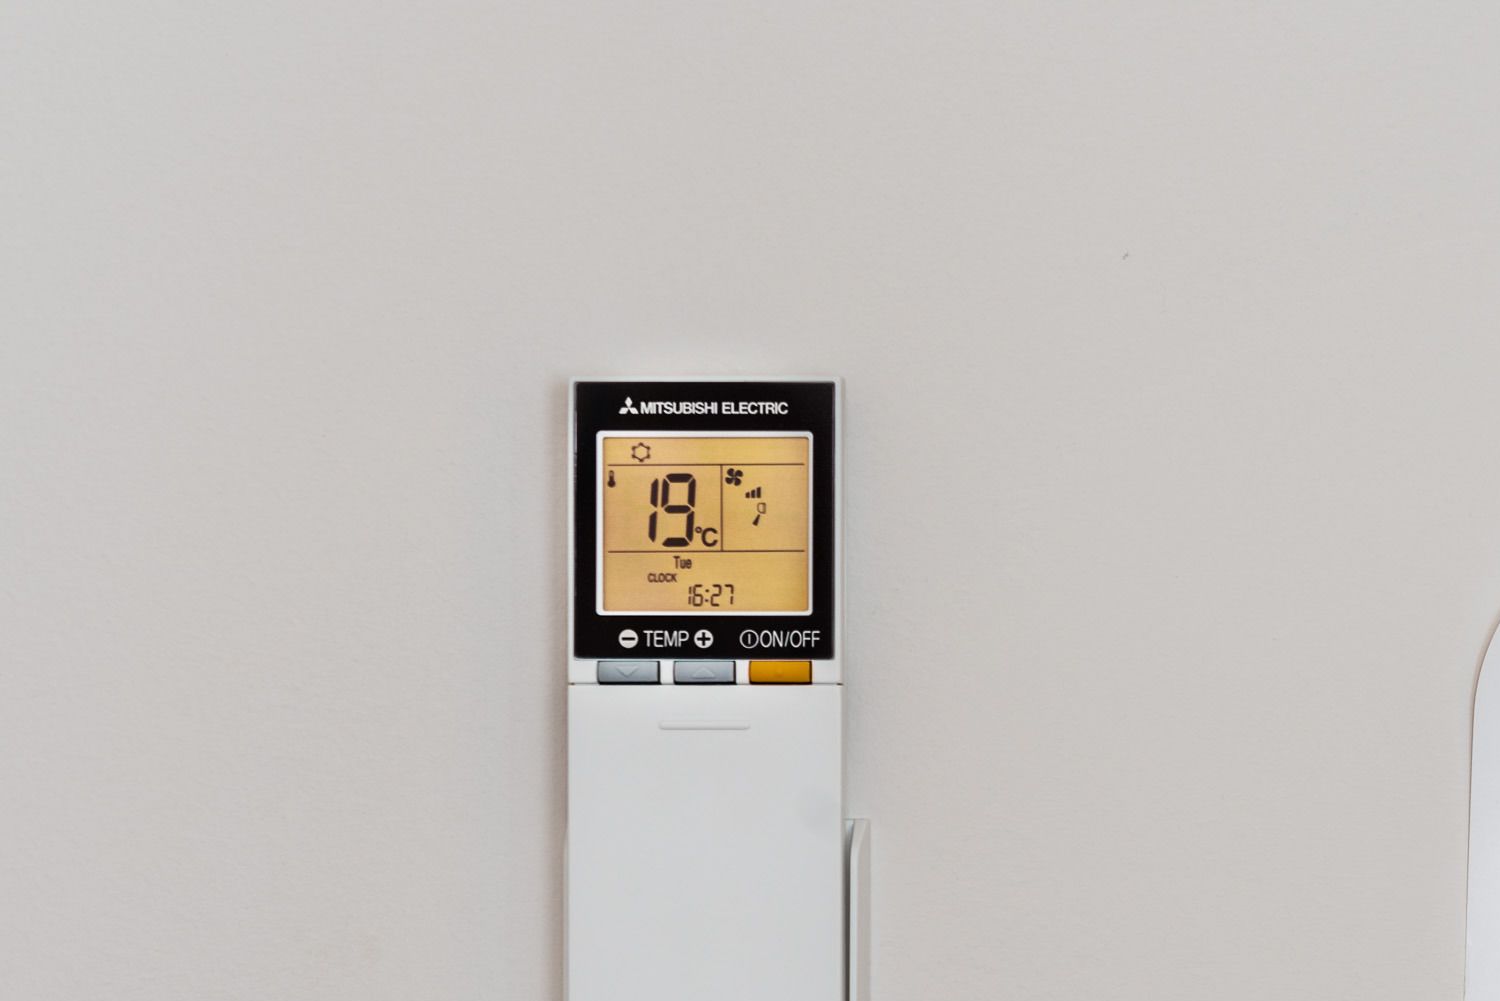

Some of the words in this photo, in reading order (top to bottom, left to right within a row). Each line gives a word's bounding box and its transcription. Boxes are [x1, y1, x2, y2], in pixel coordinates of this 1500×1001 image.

[641, 401, 718, 415] MITSUBISHI
[722, 401, 789, 415] ELECTRIC
[673, 556, 692, 569] Tue
[647, 573, 677, 583] CLOCK
[688, 584, 734, 607] 16:27
[643, 631, 690, 647] TEMP
[758, 630, 821, 648] ON/OFF
